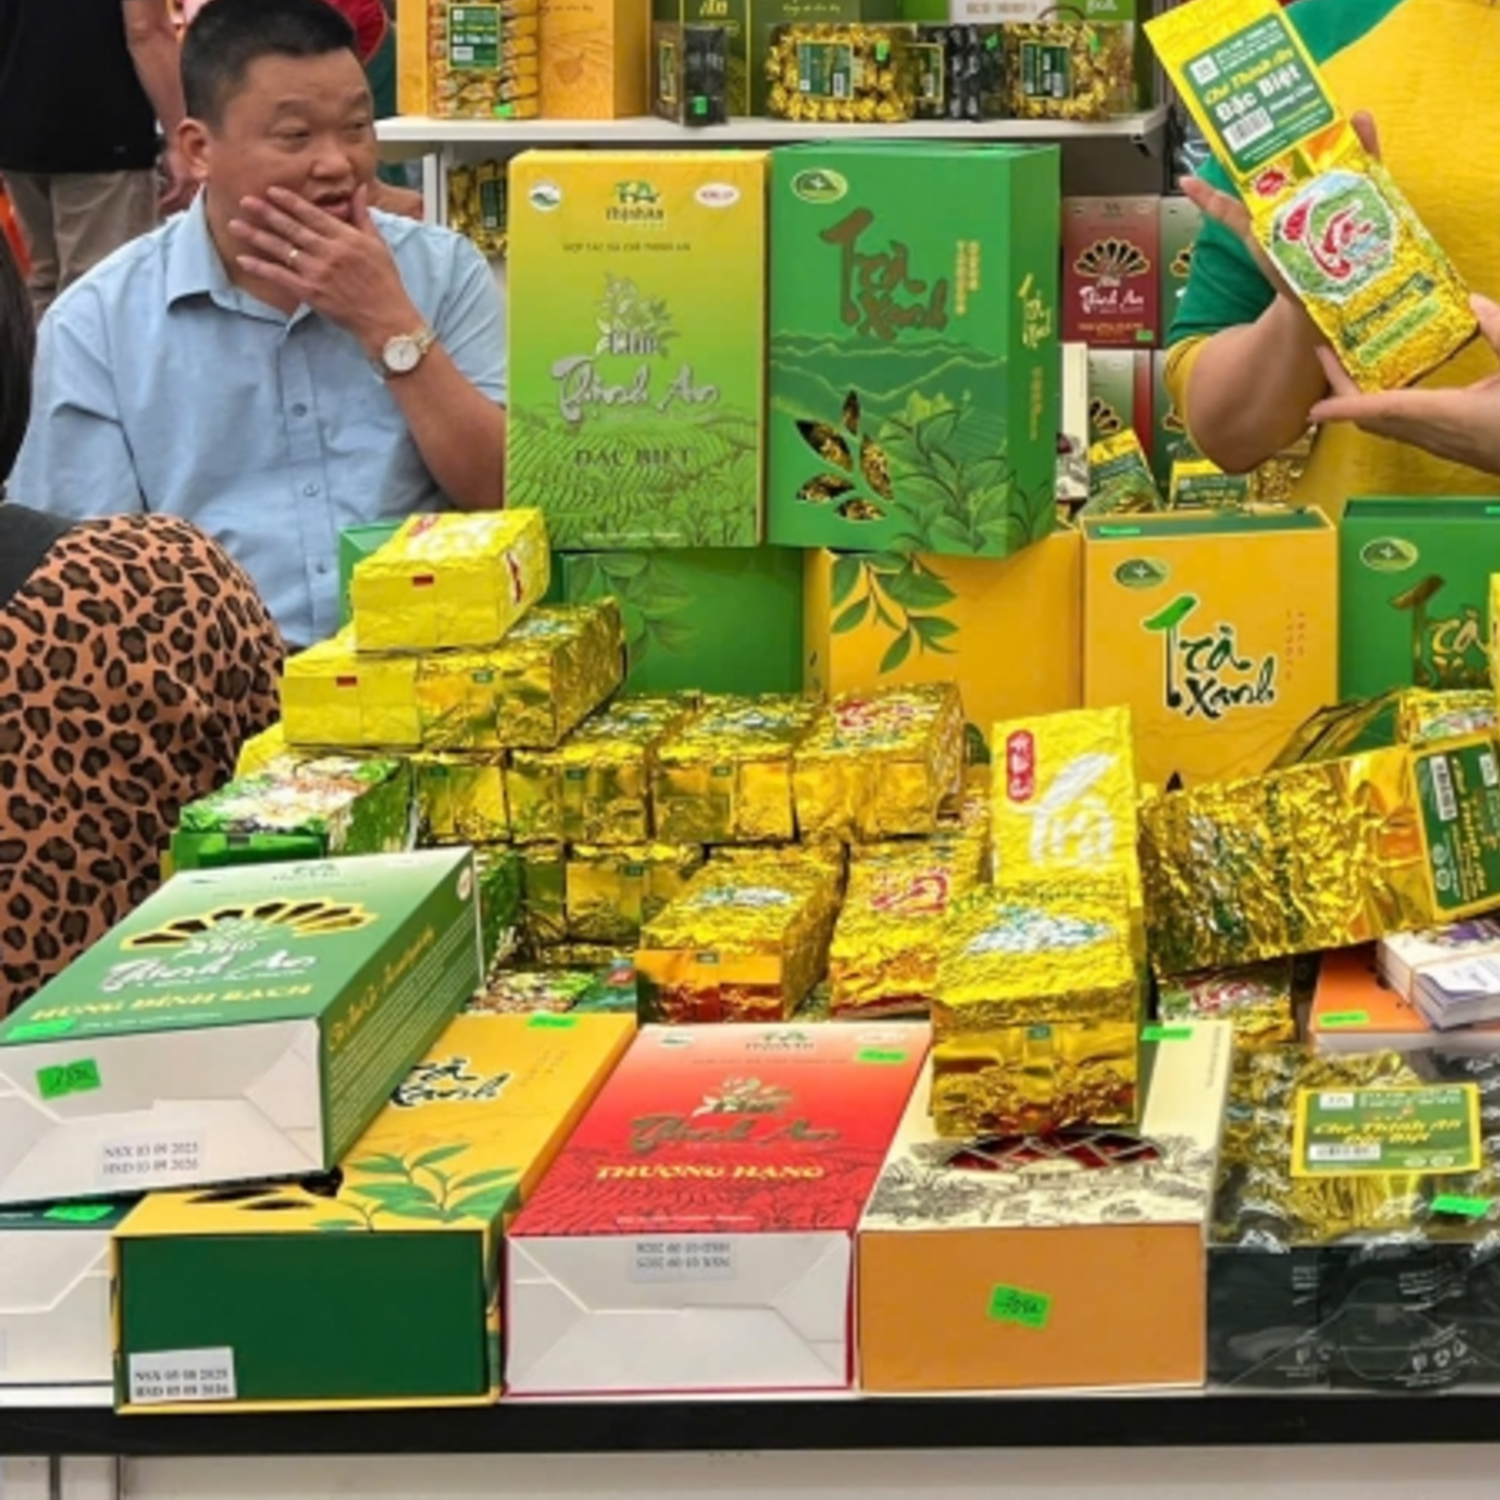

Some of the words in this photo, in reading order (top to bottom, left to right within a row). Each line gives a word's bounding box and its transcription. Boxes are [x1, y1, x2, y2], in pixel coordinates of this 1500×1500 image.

[1215, 91, 1258, 123] Đặc
[1258, 63, 1302, 98] Biệt
[1141, 594, 1250, 710] Trà
[1184, 656, 1276, 720] Xanh
